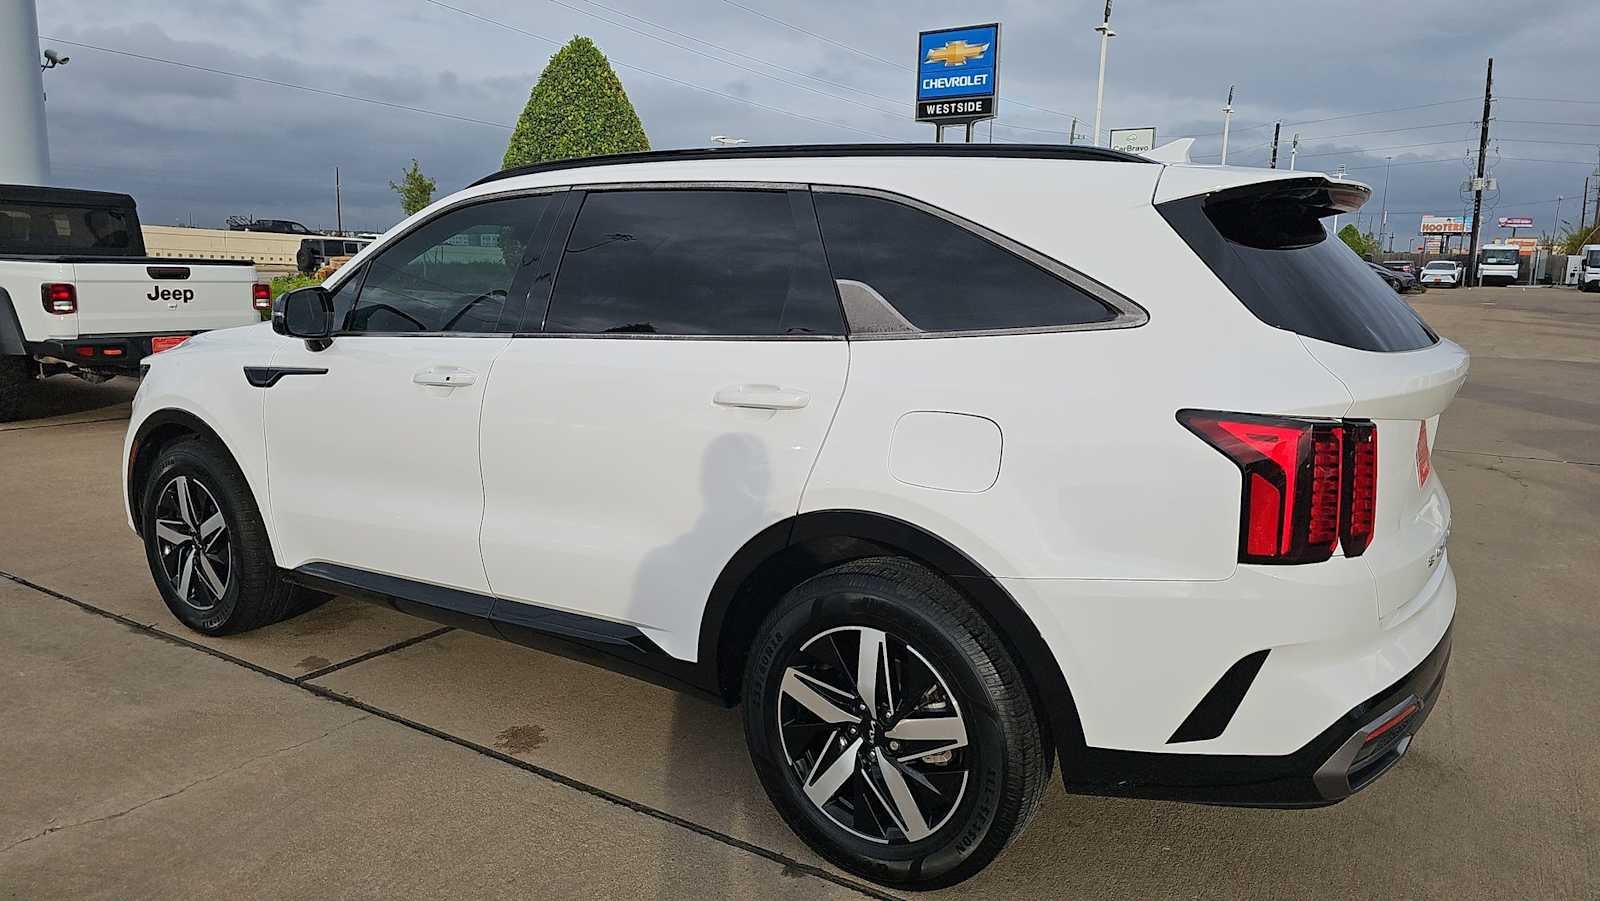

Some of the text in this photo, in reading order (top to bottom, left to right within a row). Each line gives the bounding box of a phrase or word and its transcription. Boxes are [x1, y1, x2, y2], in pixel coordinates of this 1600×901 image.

[922, 74, 988, 89] CHEVROLET
[926, 101, 983, 114] WESTSIDE
[146, 285, 194, 304] Jeep
